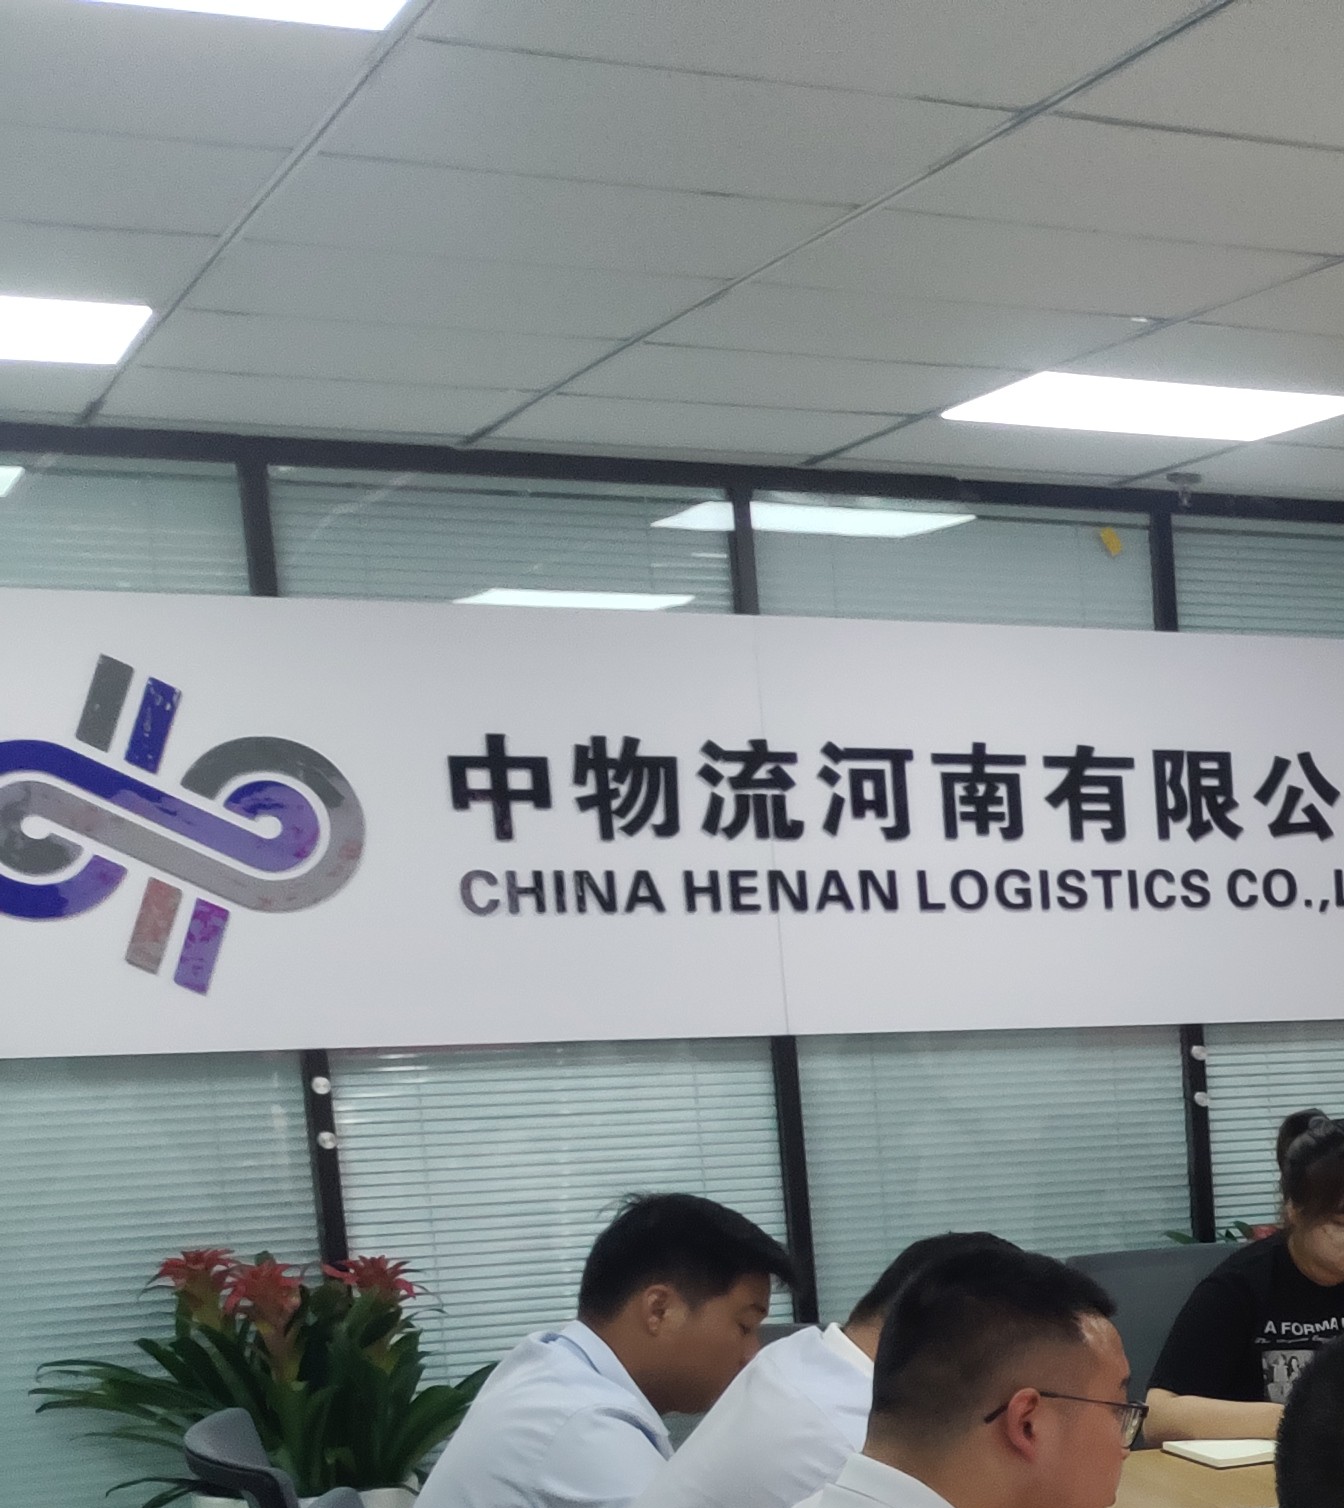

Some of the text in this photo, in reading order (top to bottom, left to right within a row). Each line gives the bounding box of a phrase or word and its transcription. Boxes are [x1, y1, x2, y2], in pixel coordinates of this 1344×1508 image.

[460, 869, 666, 915] CHINA
[683, 869, 899, 913] HENAN
[917, 868, 1211, 911] LOGISTICS
[1264, 1320, 1277, 1335] A
[1281, 1317, 1339, 1336] FORMA
